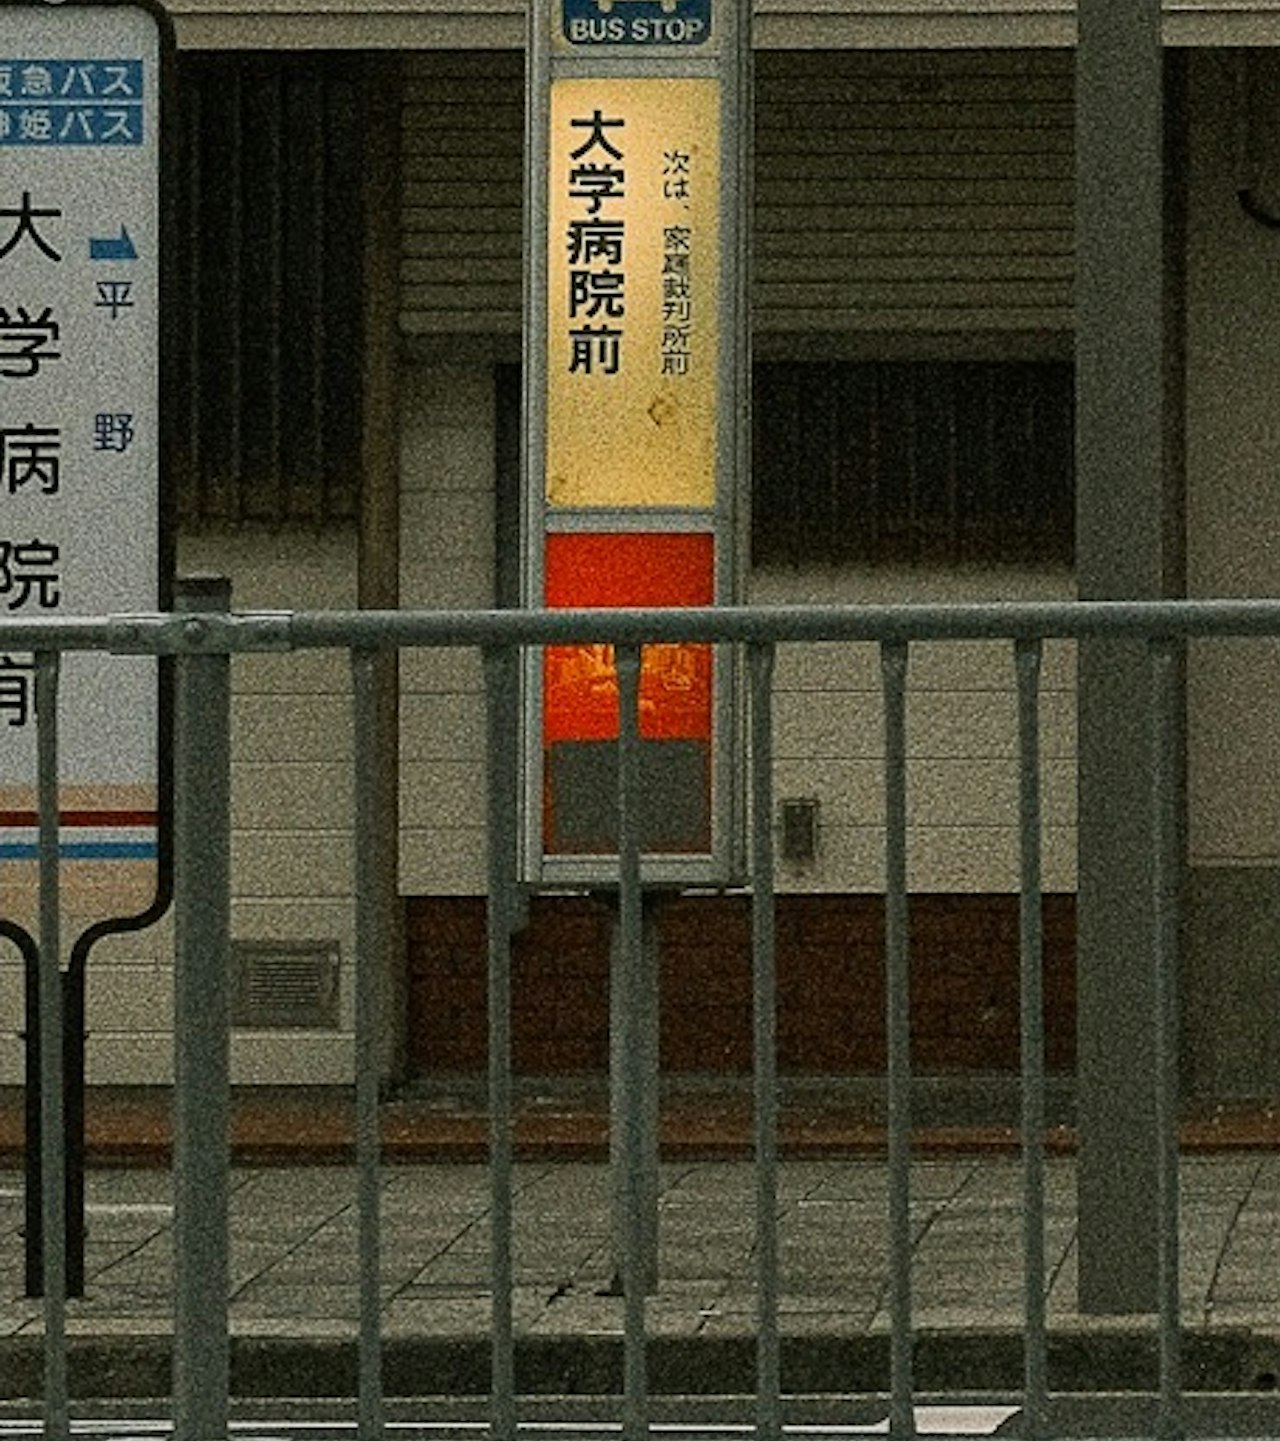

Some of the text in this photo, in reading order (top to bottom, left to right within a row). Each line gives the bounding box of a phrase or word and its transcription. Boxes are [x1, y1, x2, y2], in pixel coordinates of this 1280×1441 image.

[572, 16, 703, 43] BUS STOP
[565, 109, 626, 377] 大学病院前
